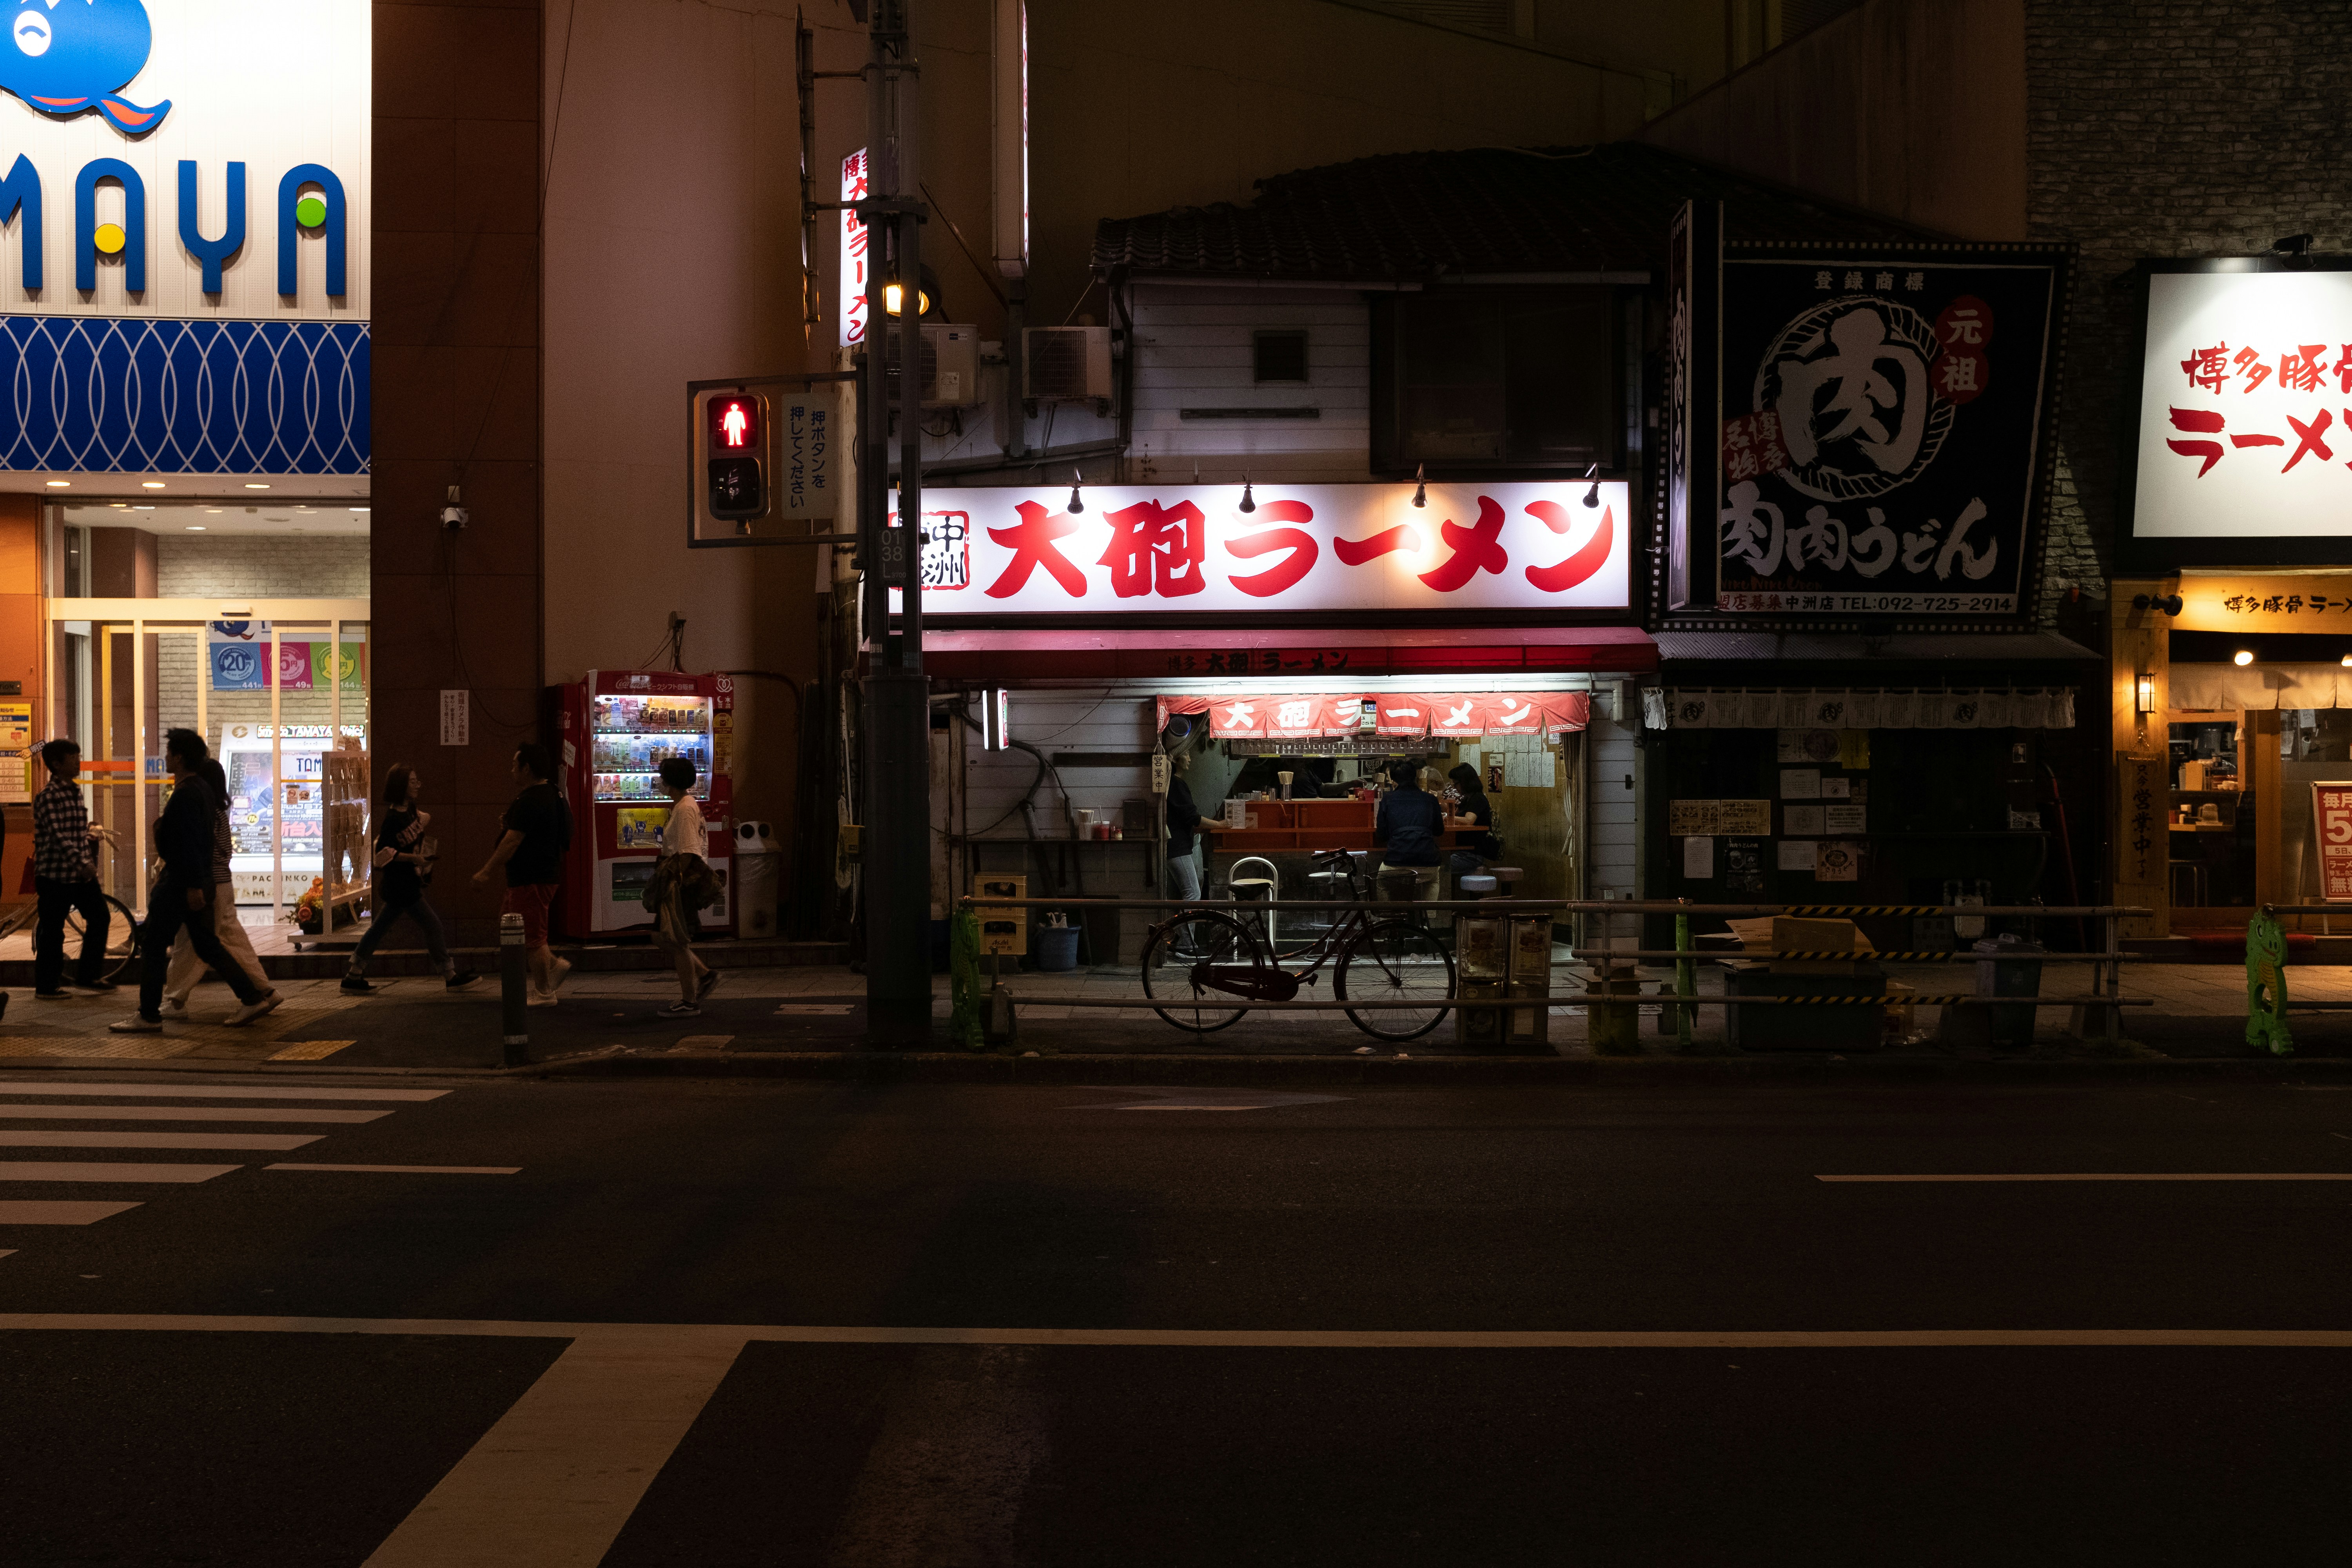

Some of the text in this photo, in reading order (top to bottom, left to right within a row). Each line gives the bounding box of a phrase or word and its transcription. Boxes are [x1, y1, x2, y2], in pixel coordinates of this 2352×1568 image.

[1814, 270, 1924, 291] 登録商標
[1940, 308, 1984, 392] 元祖
[1776, 307, 1928, 475] 肉
[790, 406, 805, 508] 押してください
[811, 410, 826, 489] 押ボタンを
[2166, 404, 2352, 479] ラーメ
[882, 530, 900, 545] 01
[984, 495, 1613, 598] 大砲ラーメン
[1722, 481, 1999, 580] 肉肉うどん
[882, 546, 903, 561] 38
[1786, 595, 1834, 610] 中洲店
[1840, 597, 2012, 611] TEL:092-725-2914
[1167, 652, 1348, 673] 博多 大砲ラーメン
[1223, 698, 1532, 729] 大砲ラーメン
[1153, 755, 1164, 791] 営業中
[2323, 792, 2352, 808] 毎月
[2330, 877, 2352, 893] 無
